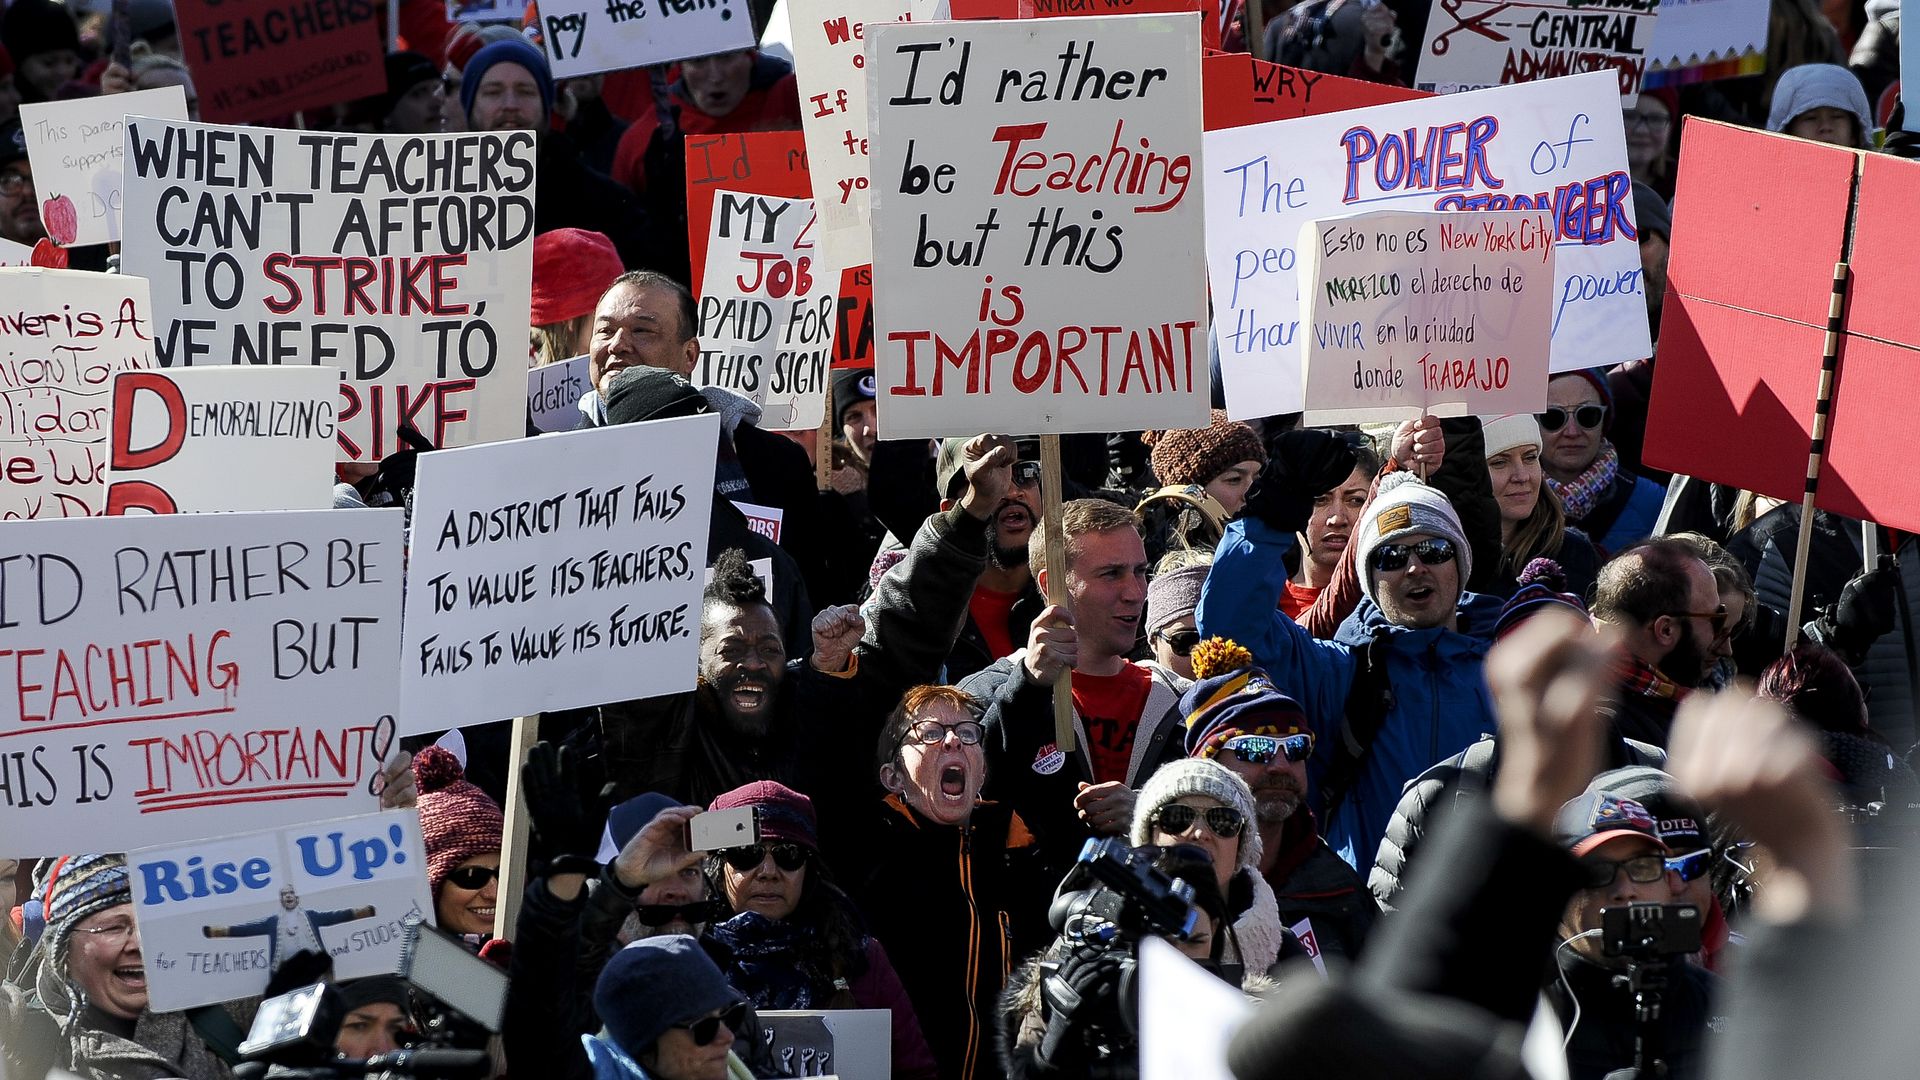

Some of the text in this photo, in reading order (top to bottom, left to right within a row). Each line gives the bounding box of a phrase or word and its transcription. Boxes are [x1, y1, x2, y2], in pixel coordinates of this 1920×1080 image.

[193, 0, 375, 62] TEACHERS
[547, 12, 588, 60] pay
[606, 0, 647, 23] the
[1530, 11, 1644, 54] CENTRAL
[889, 37, 1167, 106] I'd rather
[1251, 60, 1323, 103] WRY
[35, 119, 68, 145] This
[810, 89, 848, 119] If
[61, 146, 124, 172] supports
[128, 123, 535, 194] WHEN TEACHERS
[690, 136, 751, 184] I'd
[900, 118, 1192, 214] be Teaching
[1224, 113, 1594, 217] The POWER of
[156, 186, 534, 257] CAN'T AFFORD
[718, 194, 791, 244] MY
[913, 207, 1124, 274] but this
[1323, 226, 1365, 258] Esto
[1376, 232, 1398, 253] no
[1406, 228, 1428, 254] es
[1440, 223, 1480, 252] New
[1483, 221, 1517, 253] York
[165, 250, 487, 317] TO STRIKE,
[736, 251, 814, 299] JOB
[979, 275, 1024, 327] is
[1231, 247, 1299, 309] peo
[1326, 263, 1524, 308] MEREZCO el derecho de
[1551, 267, 1643, 338] power.
[63, 304, 104, 338] is
[110, 298, 152, 340] A
[698, 294, 833, 345] PAID FOR
[1314, 313, 1476, 352] VIVIR en la ciudad
[155, 318, 499, 381] WE NEED TO
[699, 349, 828, 395] THIS SIGN
[888, 321, 1197, 397] IMPORTANT
[1353, 352, 1511, 392] donde TRABAJO
[0, 391, 106, 435] lidar
[436, 474, 686, 551] A DISTRICT THAT FAILS
[0, 538, 382, 628] I'D RATHER BE
[468, 564, 537, 610] VALUE
[551, 557, 584, 598] ITS
[588, 541, 694, 591] TEACHERS,
[272, 617, 379, 680] BUT
[420, 634, 473, 677] FAILS
[511, 624, 567, 666] VALUE
[573, 620, 601, 654] ITS
[610, 603, 690, 650] FUTURE.
[72, 744, 114, 804] IS
[138, 824, 406, 905] Rise Up!
[186, 949, 269, 974] TEACHERS
